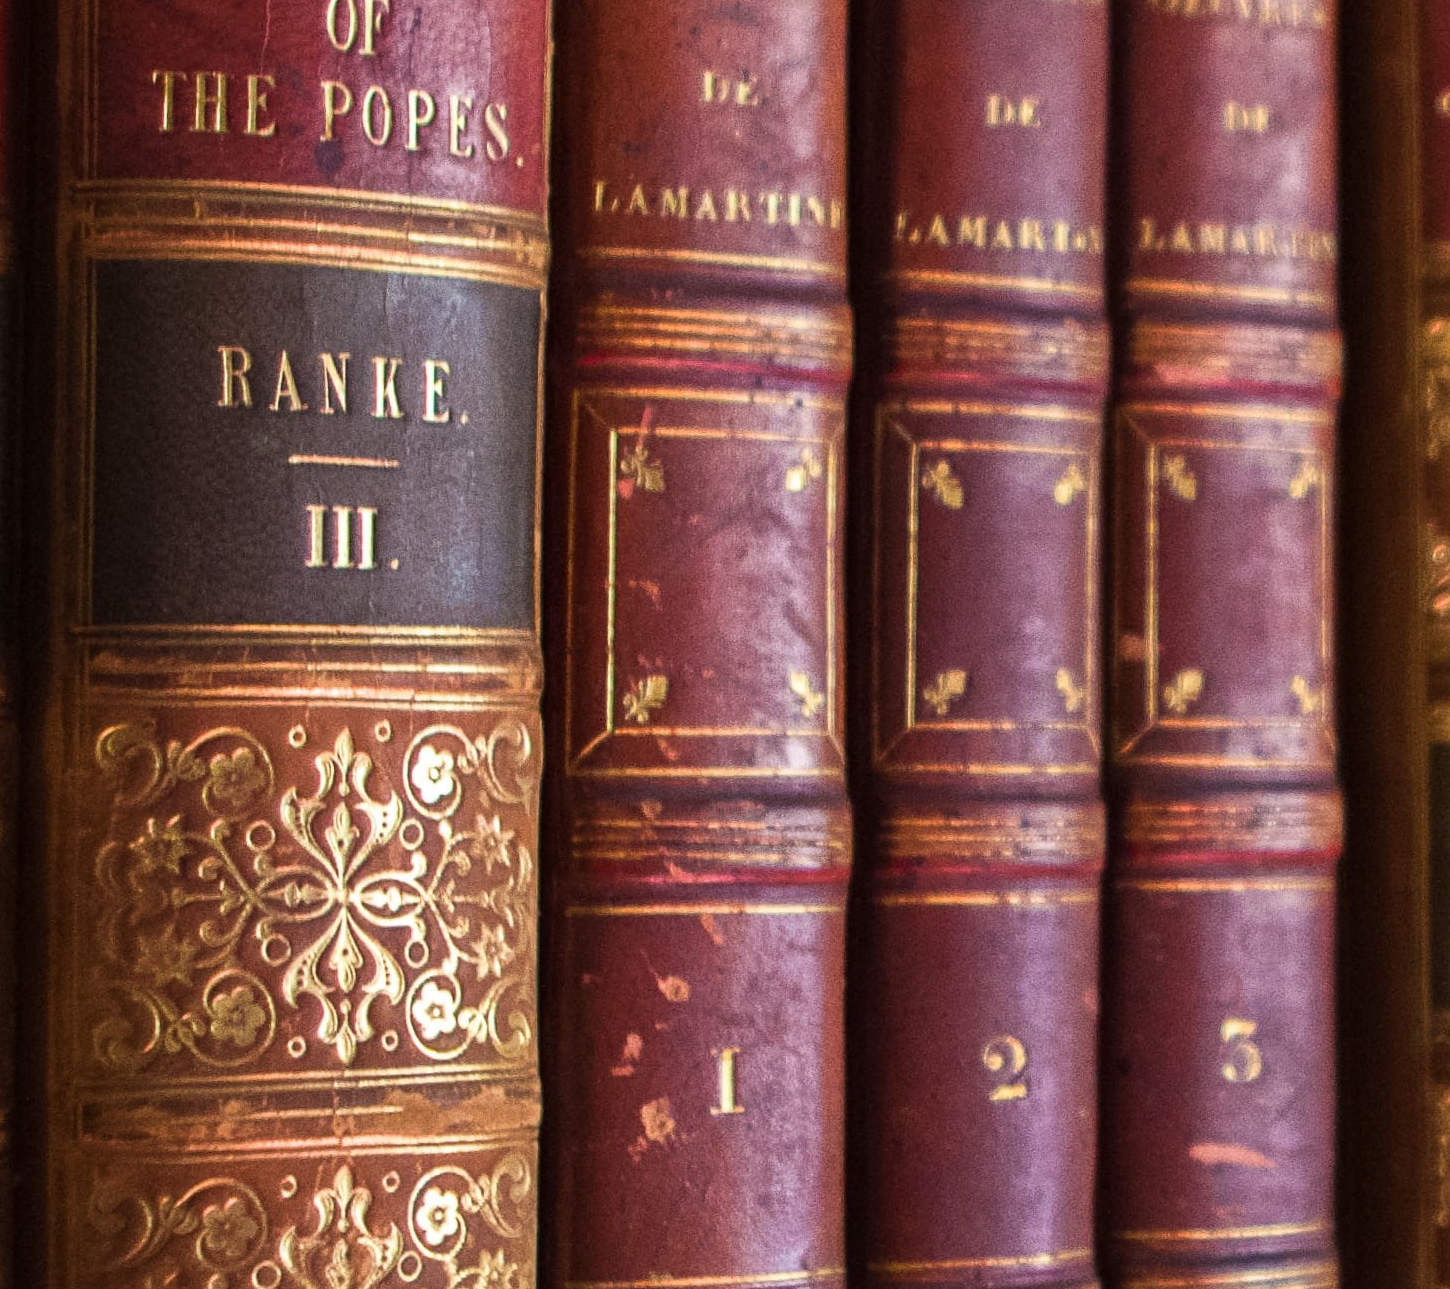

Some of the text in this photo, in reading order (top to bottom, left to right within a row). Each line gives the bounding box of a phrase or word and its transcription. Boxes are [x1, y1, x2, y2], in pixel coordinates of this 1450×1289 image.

[152, 70, 277, 136] THE
[217, 345, 469, 423] RANKE.
[305, 504, 400, 571] III.
[982, 1034, 1028, 1101] 2
